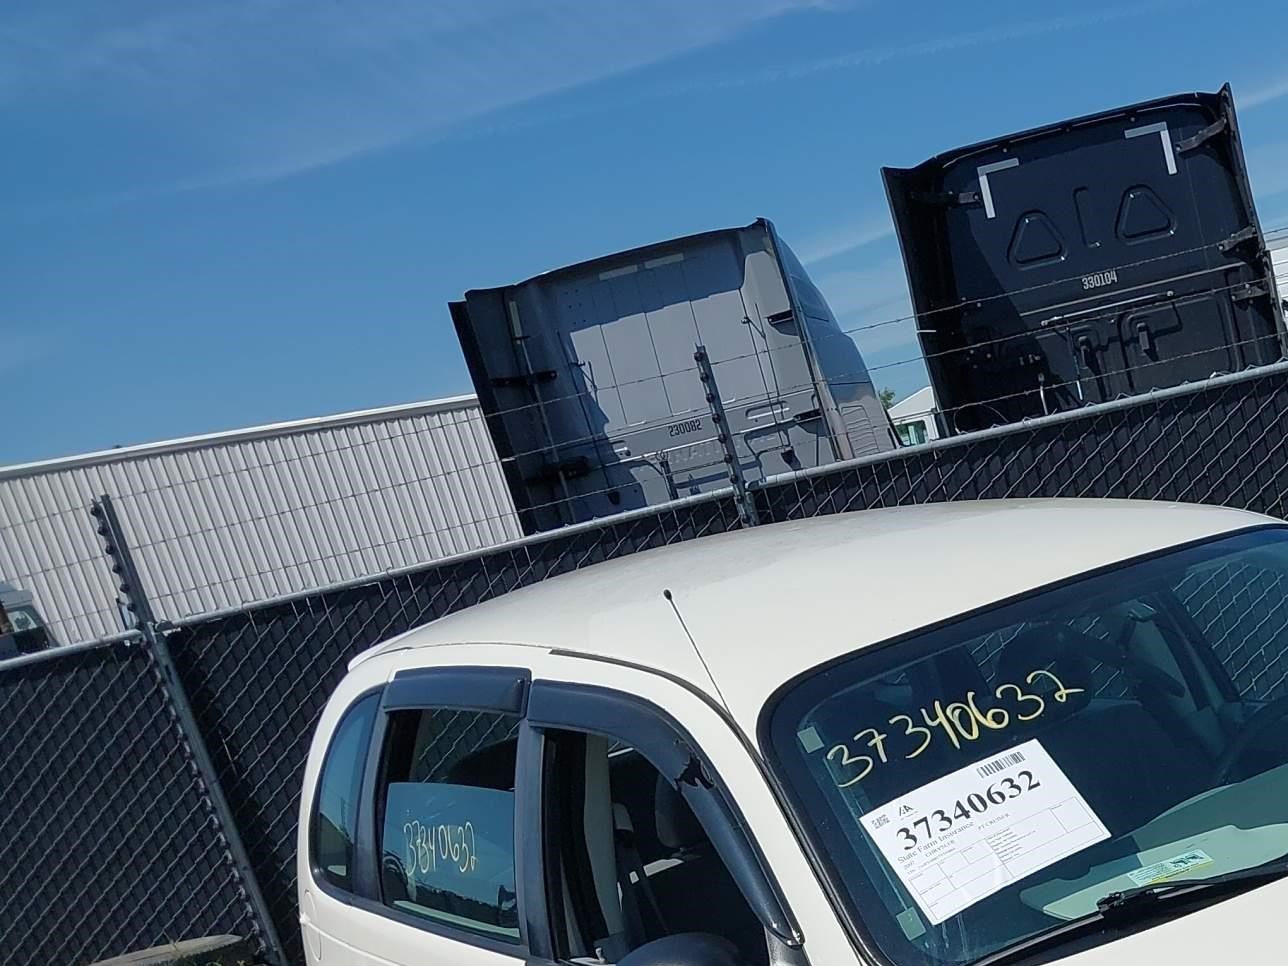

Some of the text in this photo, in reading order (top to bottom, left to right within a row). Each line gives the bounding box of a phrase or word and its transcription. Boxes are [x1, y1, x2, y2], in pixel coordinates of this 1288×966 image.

[1082, 269, 1117, 289] 330104
[668, 420, 702, 437] 230082
[827, 670, 1085, 787] 37340632
[896, 770, 1040, 850] 37340632
[403, 820, 478, 876] 37340632
[897, 849, 918, 863] State
[918, 838, 938, 853] Farm
[938, 821, 975, 843] Insurance
